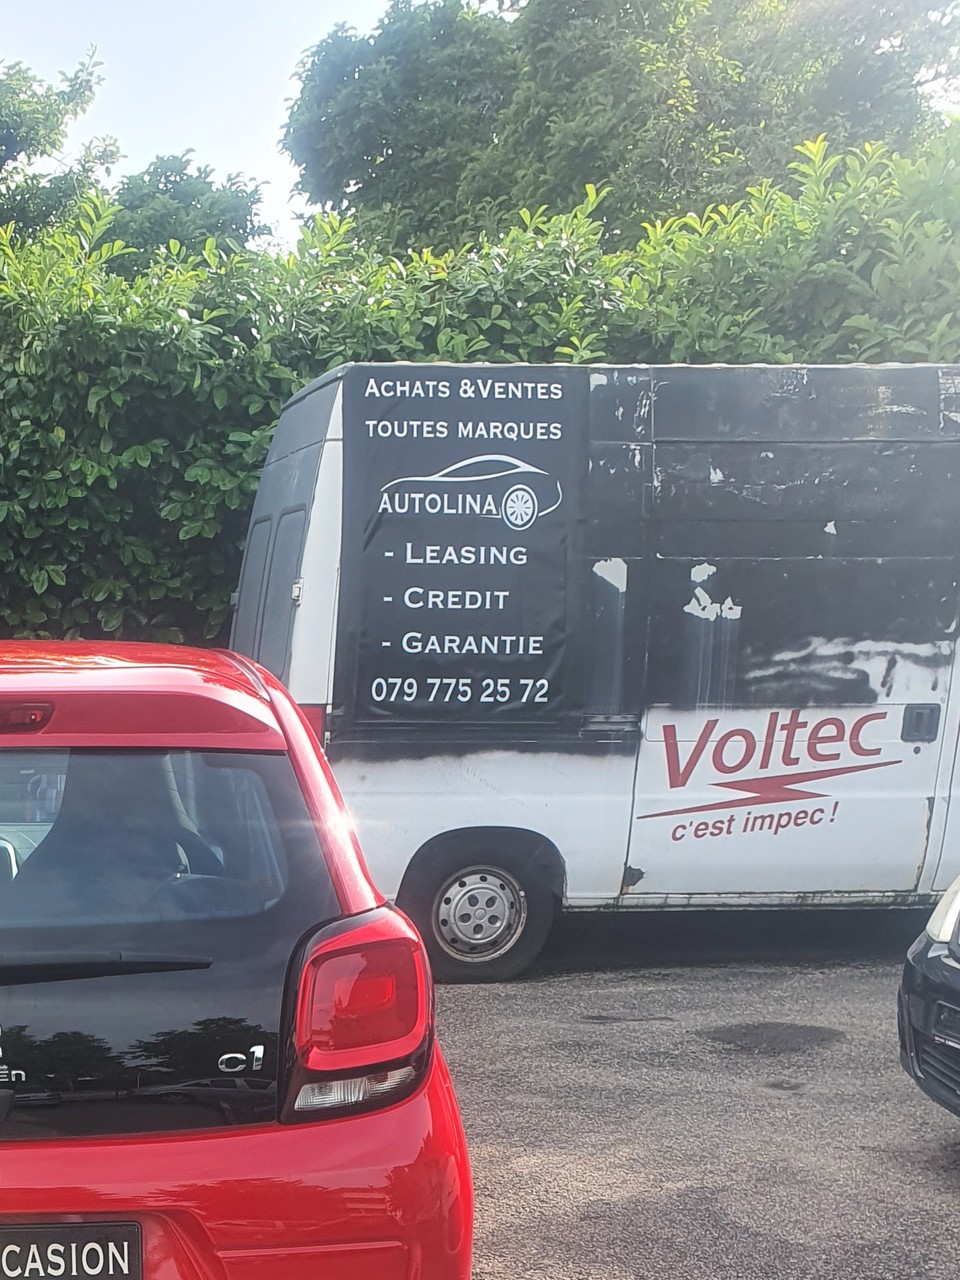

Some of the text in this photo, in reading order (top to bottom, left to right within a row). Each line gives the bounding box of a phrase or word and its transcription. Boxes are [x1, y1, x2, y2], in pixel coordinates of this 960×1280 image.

[364, 378, 451, 398] ACHATS
[365, 420, 562, 442] TOUTES MARQUES
[378, 492, 498, 515] AUTOLINA
[405, 542, 528, 565] LEASING
[403, 586, 510, 609] CREDIT
[401, 631, 544, 655] GARANTIE
[371, 677, 549, 703] 079 775 25 72
[662, 708, 888, 789] Voltec
[670, 814, 736, 842] c'est
